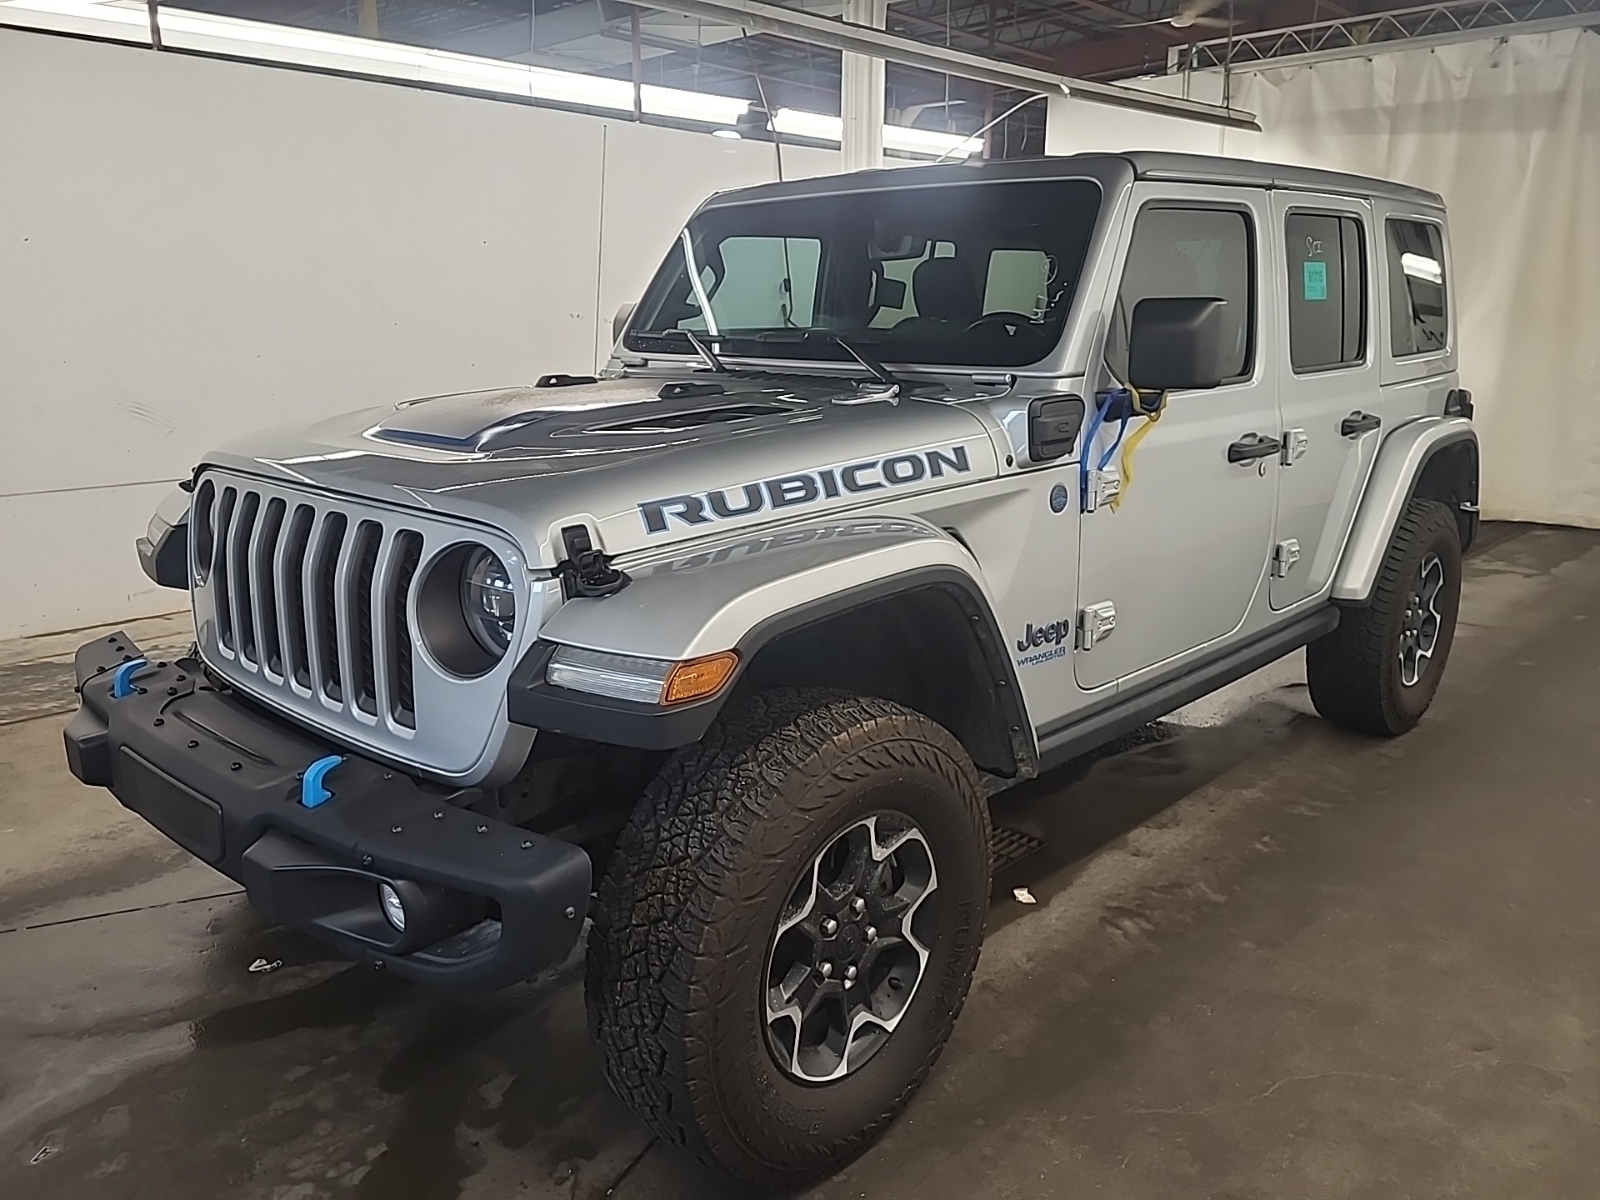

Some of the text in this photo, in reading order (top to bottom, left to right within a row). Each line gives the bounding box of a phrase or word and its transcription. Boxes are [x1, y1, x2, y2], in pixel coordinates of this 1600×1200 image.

[637, 445, 972, 535] RUBICON
[1017, 618, 1069, 652] Jeep
[1016, 646, 1066, 667] WRANGLER
